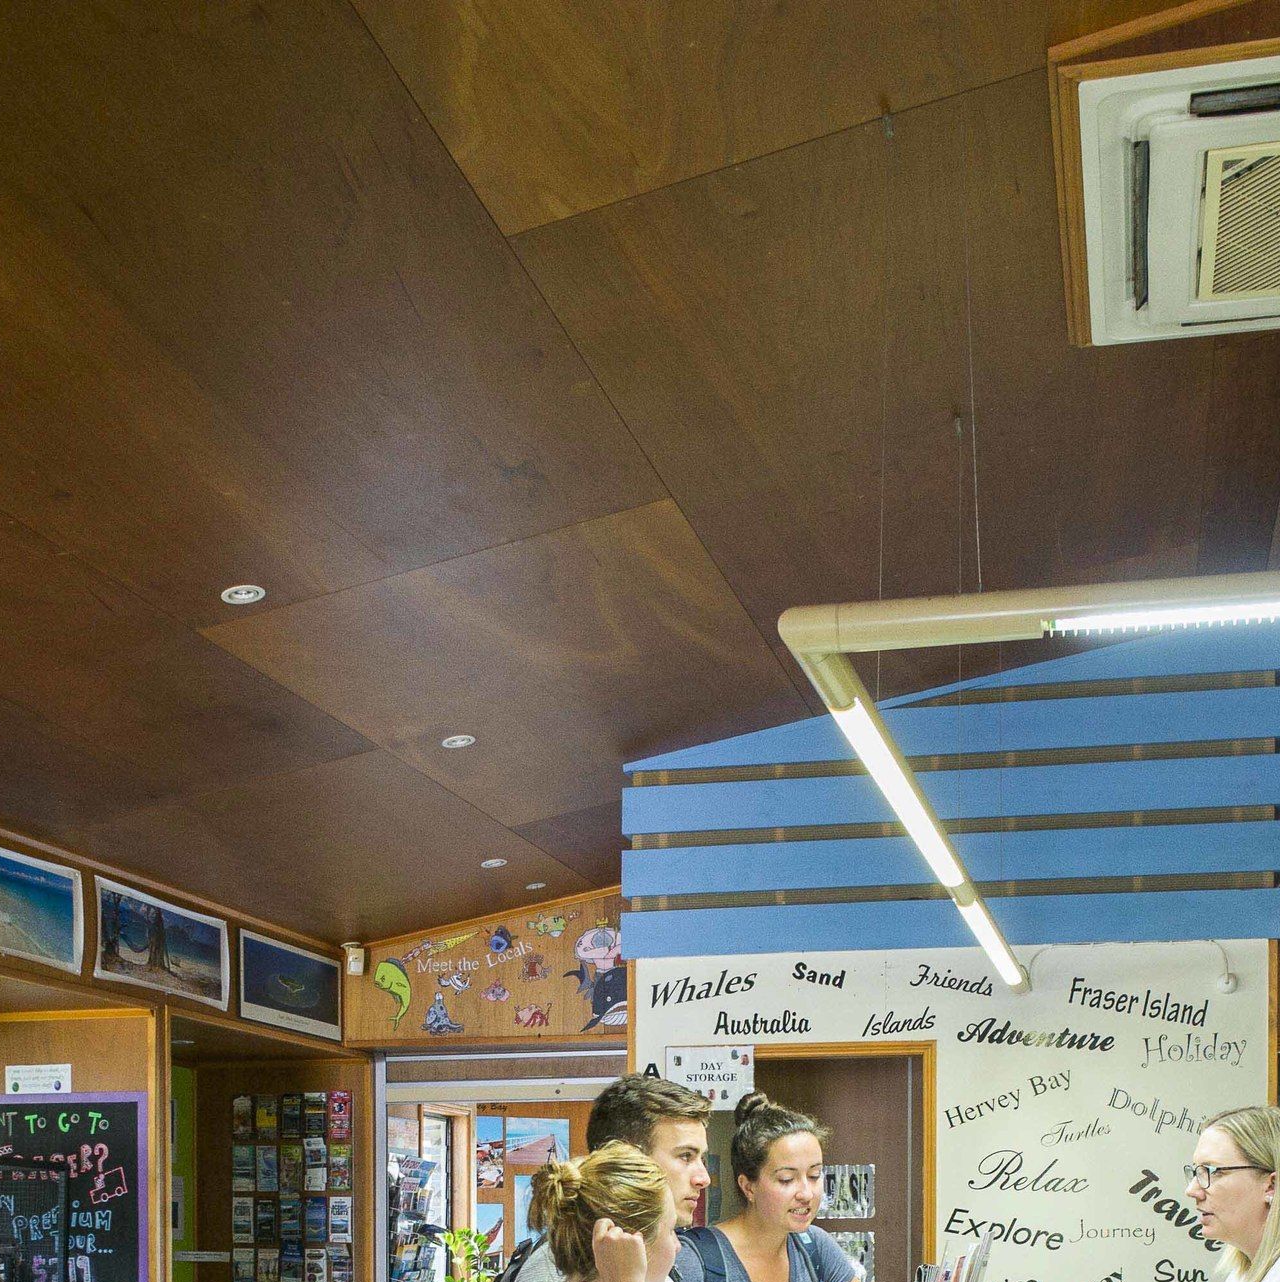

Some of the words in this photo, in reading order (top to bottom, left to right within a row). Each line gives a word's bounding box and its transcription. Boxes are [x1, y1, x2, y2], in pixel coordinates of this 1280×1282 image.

[417, 958, 453, 973] Meet
[458, 957, 480, 971] the
[485, 941, 533, 968] Locals
[651, 970, 758, 1008] Whales
[792, 962, 846, 989] Sand
[910, 964, 993, 997] Friends
[1069, 977, 1139, 1016] Fraser
[1142, 989, 1209, 1027] Island
[714, 1011, 811, 1035] Australia
[862, 1006, 936, 1037] Islands
[957, 1018, 1115, 1051] Adventure
[1142, 1032, 1246, 1068] Holiday
[686, 1073, 738, 1082] STORAGE
[700, 1062, 723, 1071] DAY
[490, 1103, 509, 1112] Bay
[945, 1088, 1020, 1128] Hervey
[1028, 1068, 1071, 1097] Bay
[1108, 1088, 1208, 1135] Dolphi
[1041, 1117, 1112, 1148] Turtles
[968, 1149, 1090, 1193] Relax
[944, 1208, 1065, 1251] Explore
[1069, 1219, 1156, 1246] Journey
[1154, 1259, 1209, 1282] Sun
